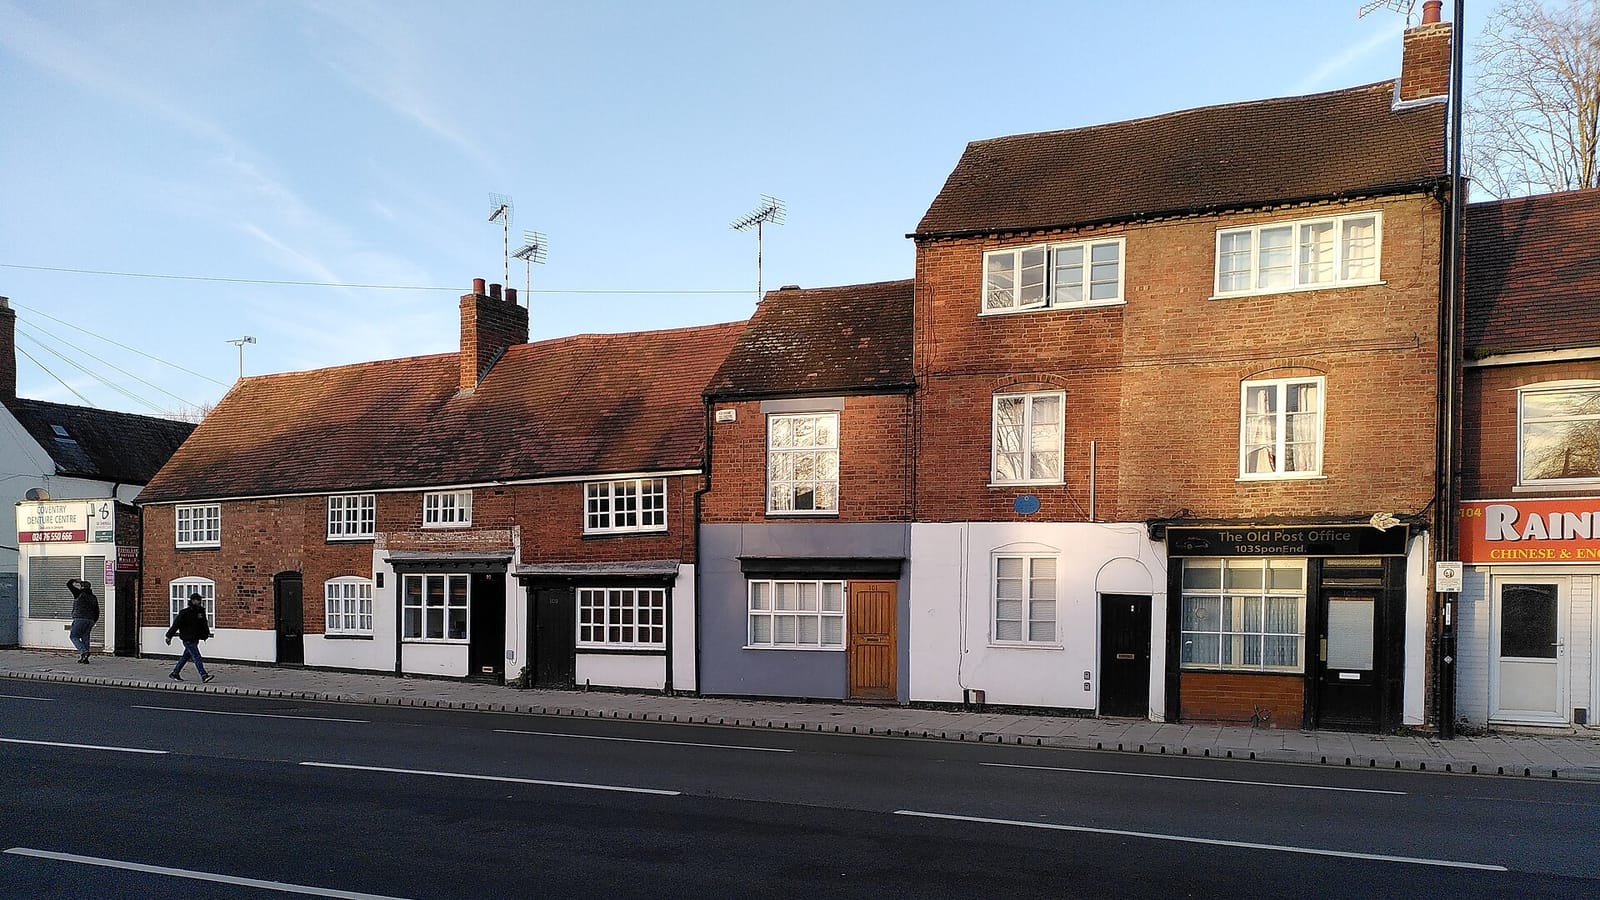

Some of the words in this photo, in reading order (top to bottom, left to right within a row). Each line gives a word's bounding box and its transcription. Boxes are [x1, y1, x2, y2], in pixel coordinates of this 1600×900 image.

[37, 505, 67, 514] COVENTRY
[27, 516, 53, 525] DENTURE
[54, 514, 77, 524] CENTRE
[1485, 504, 1600, 541] RAIN
[32, 532, 42, 542] 024
[1218, 532, 1243, 542] The
[1246, 531, 1270, 542] Old
[1274, 531, 1304, 542] Post
[1308, 530, 1352, 541] Office
[1490, 548, 1555, 559] CHINESE
[1560, 548, 1572, 559] &
